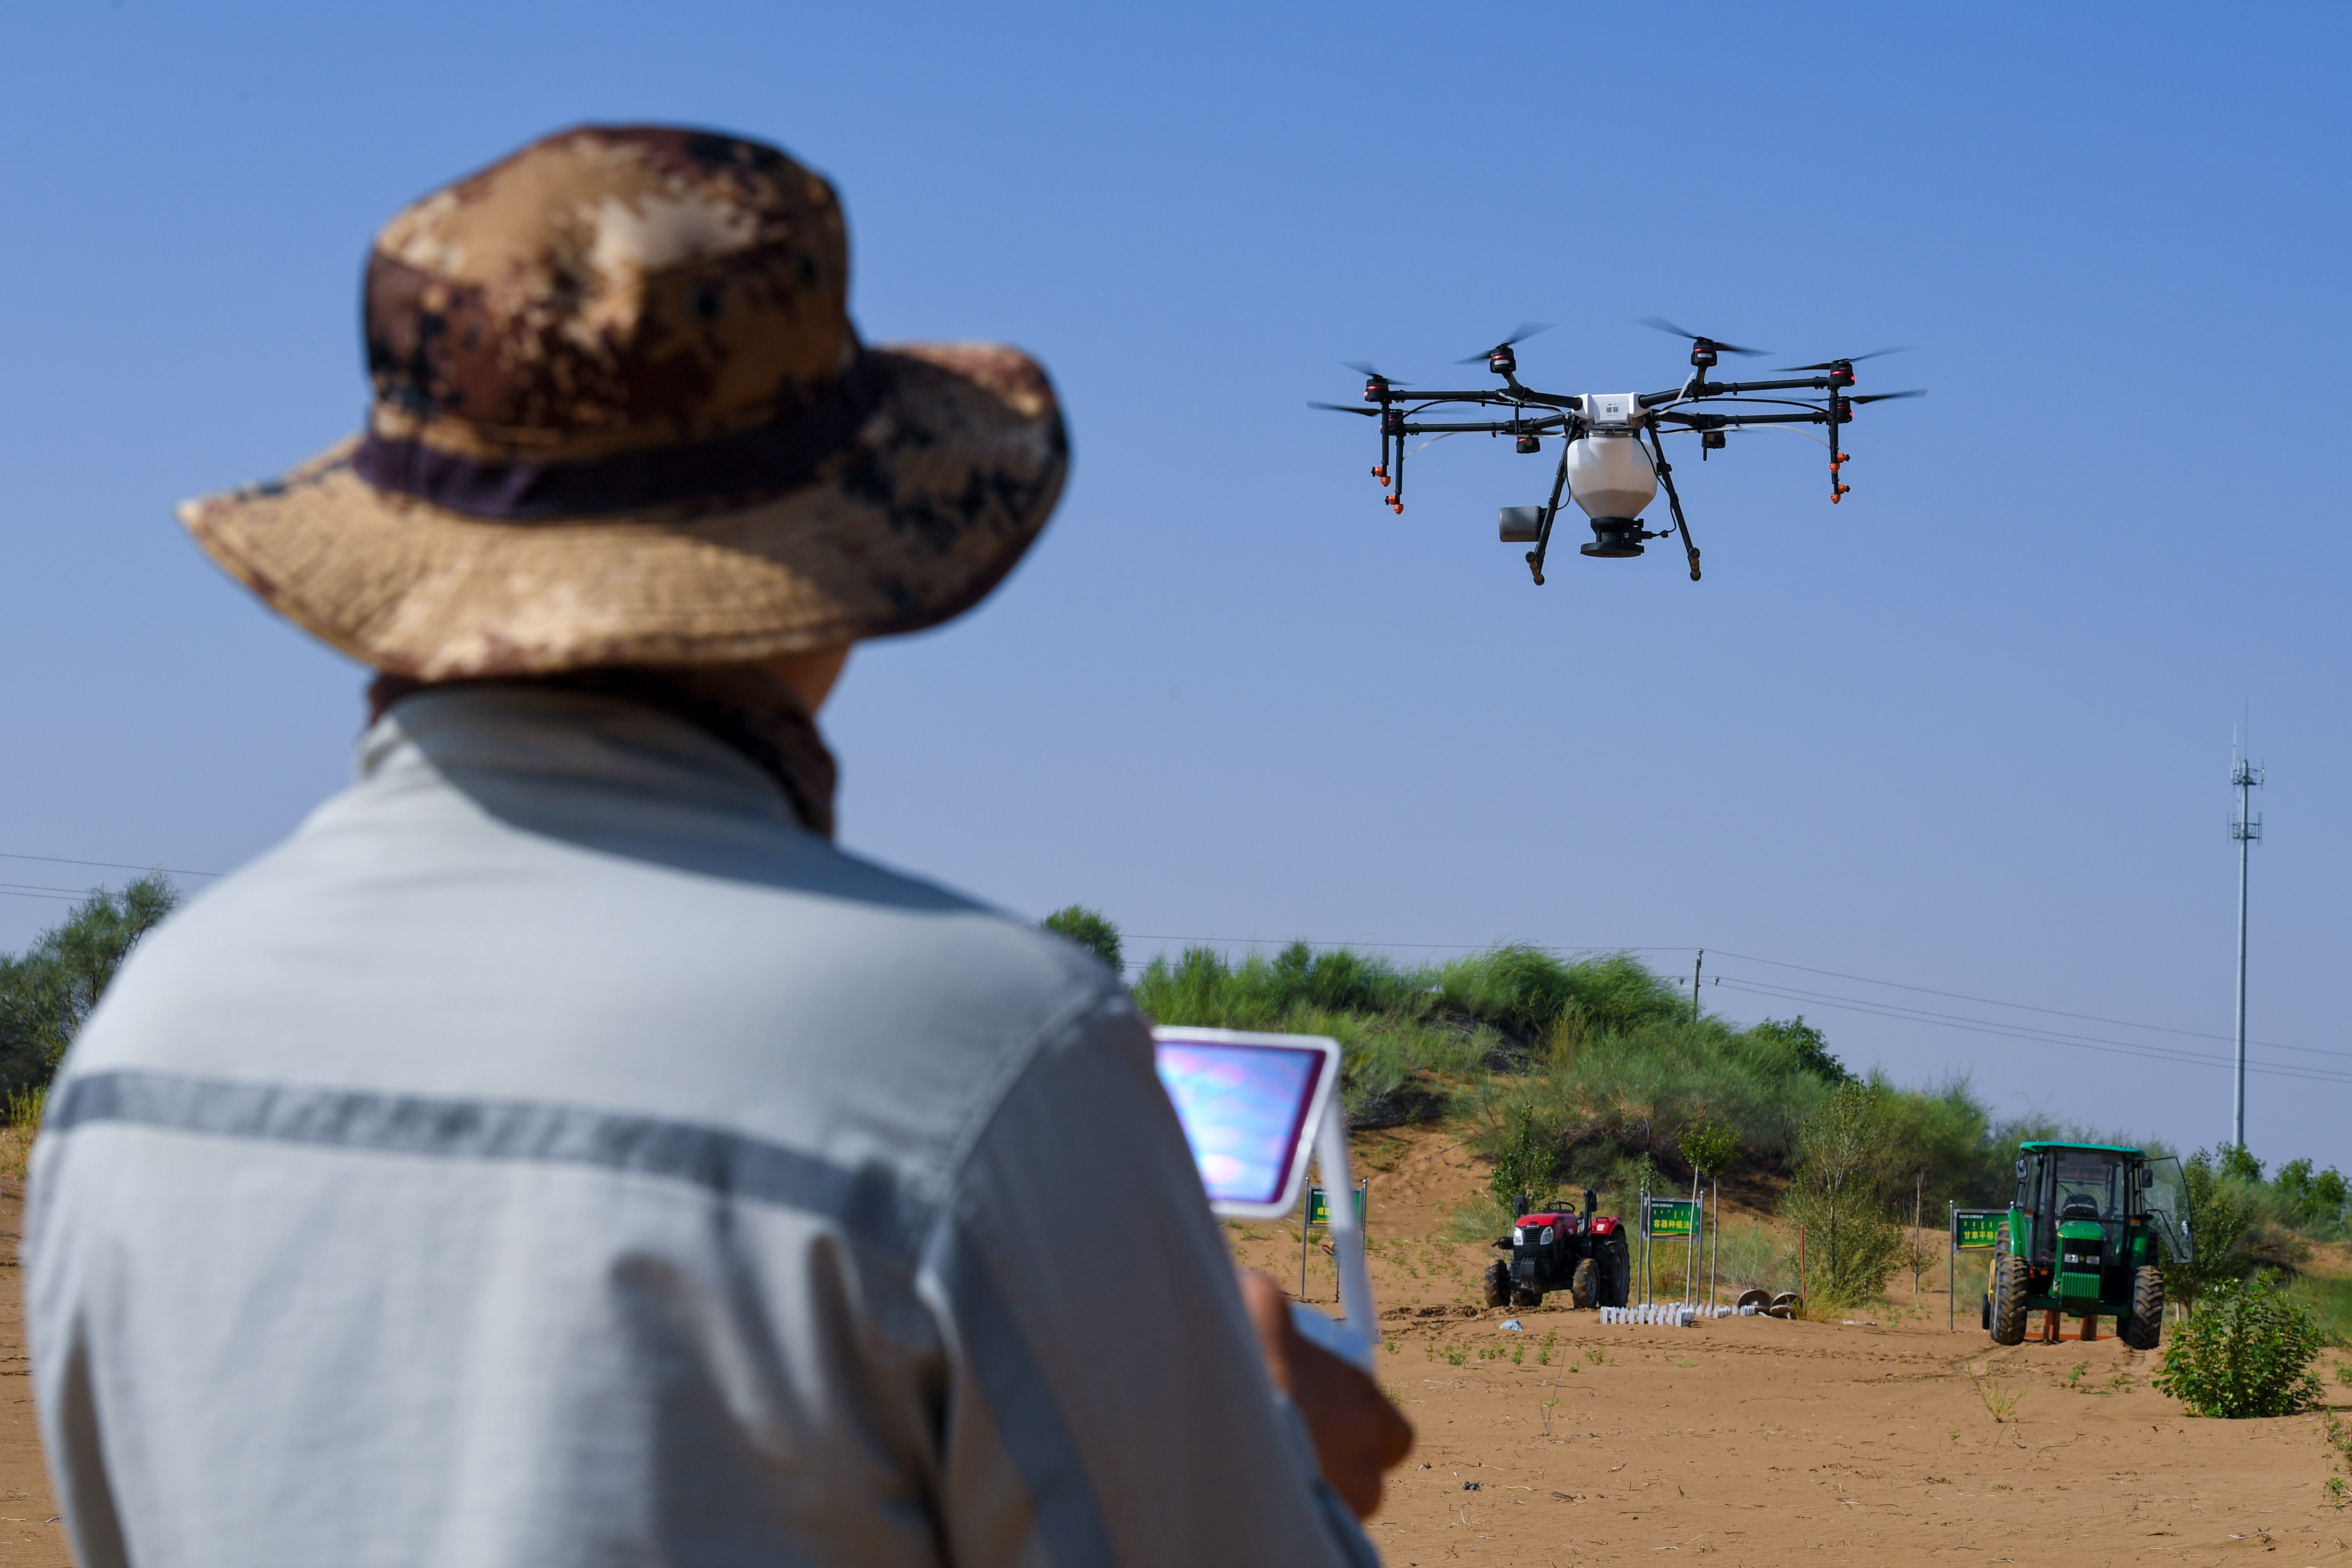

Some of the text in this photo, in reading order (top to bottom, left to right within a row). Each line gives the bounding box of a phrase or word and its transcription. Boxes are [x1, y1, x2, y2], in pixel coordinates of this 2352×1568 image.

[1653, 1219, 1691, 1229] 容器种植法
